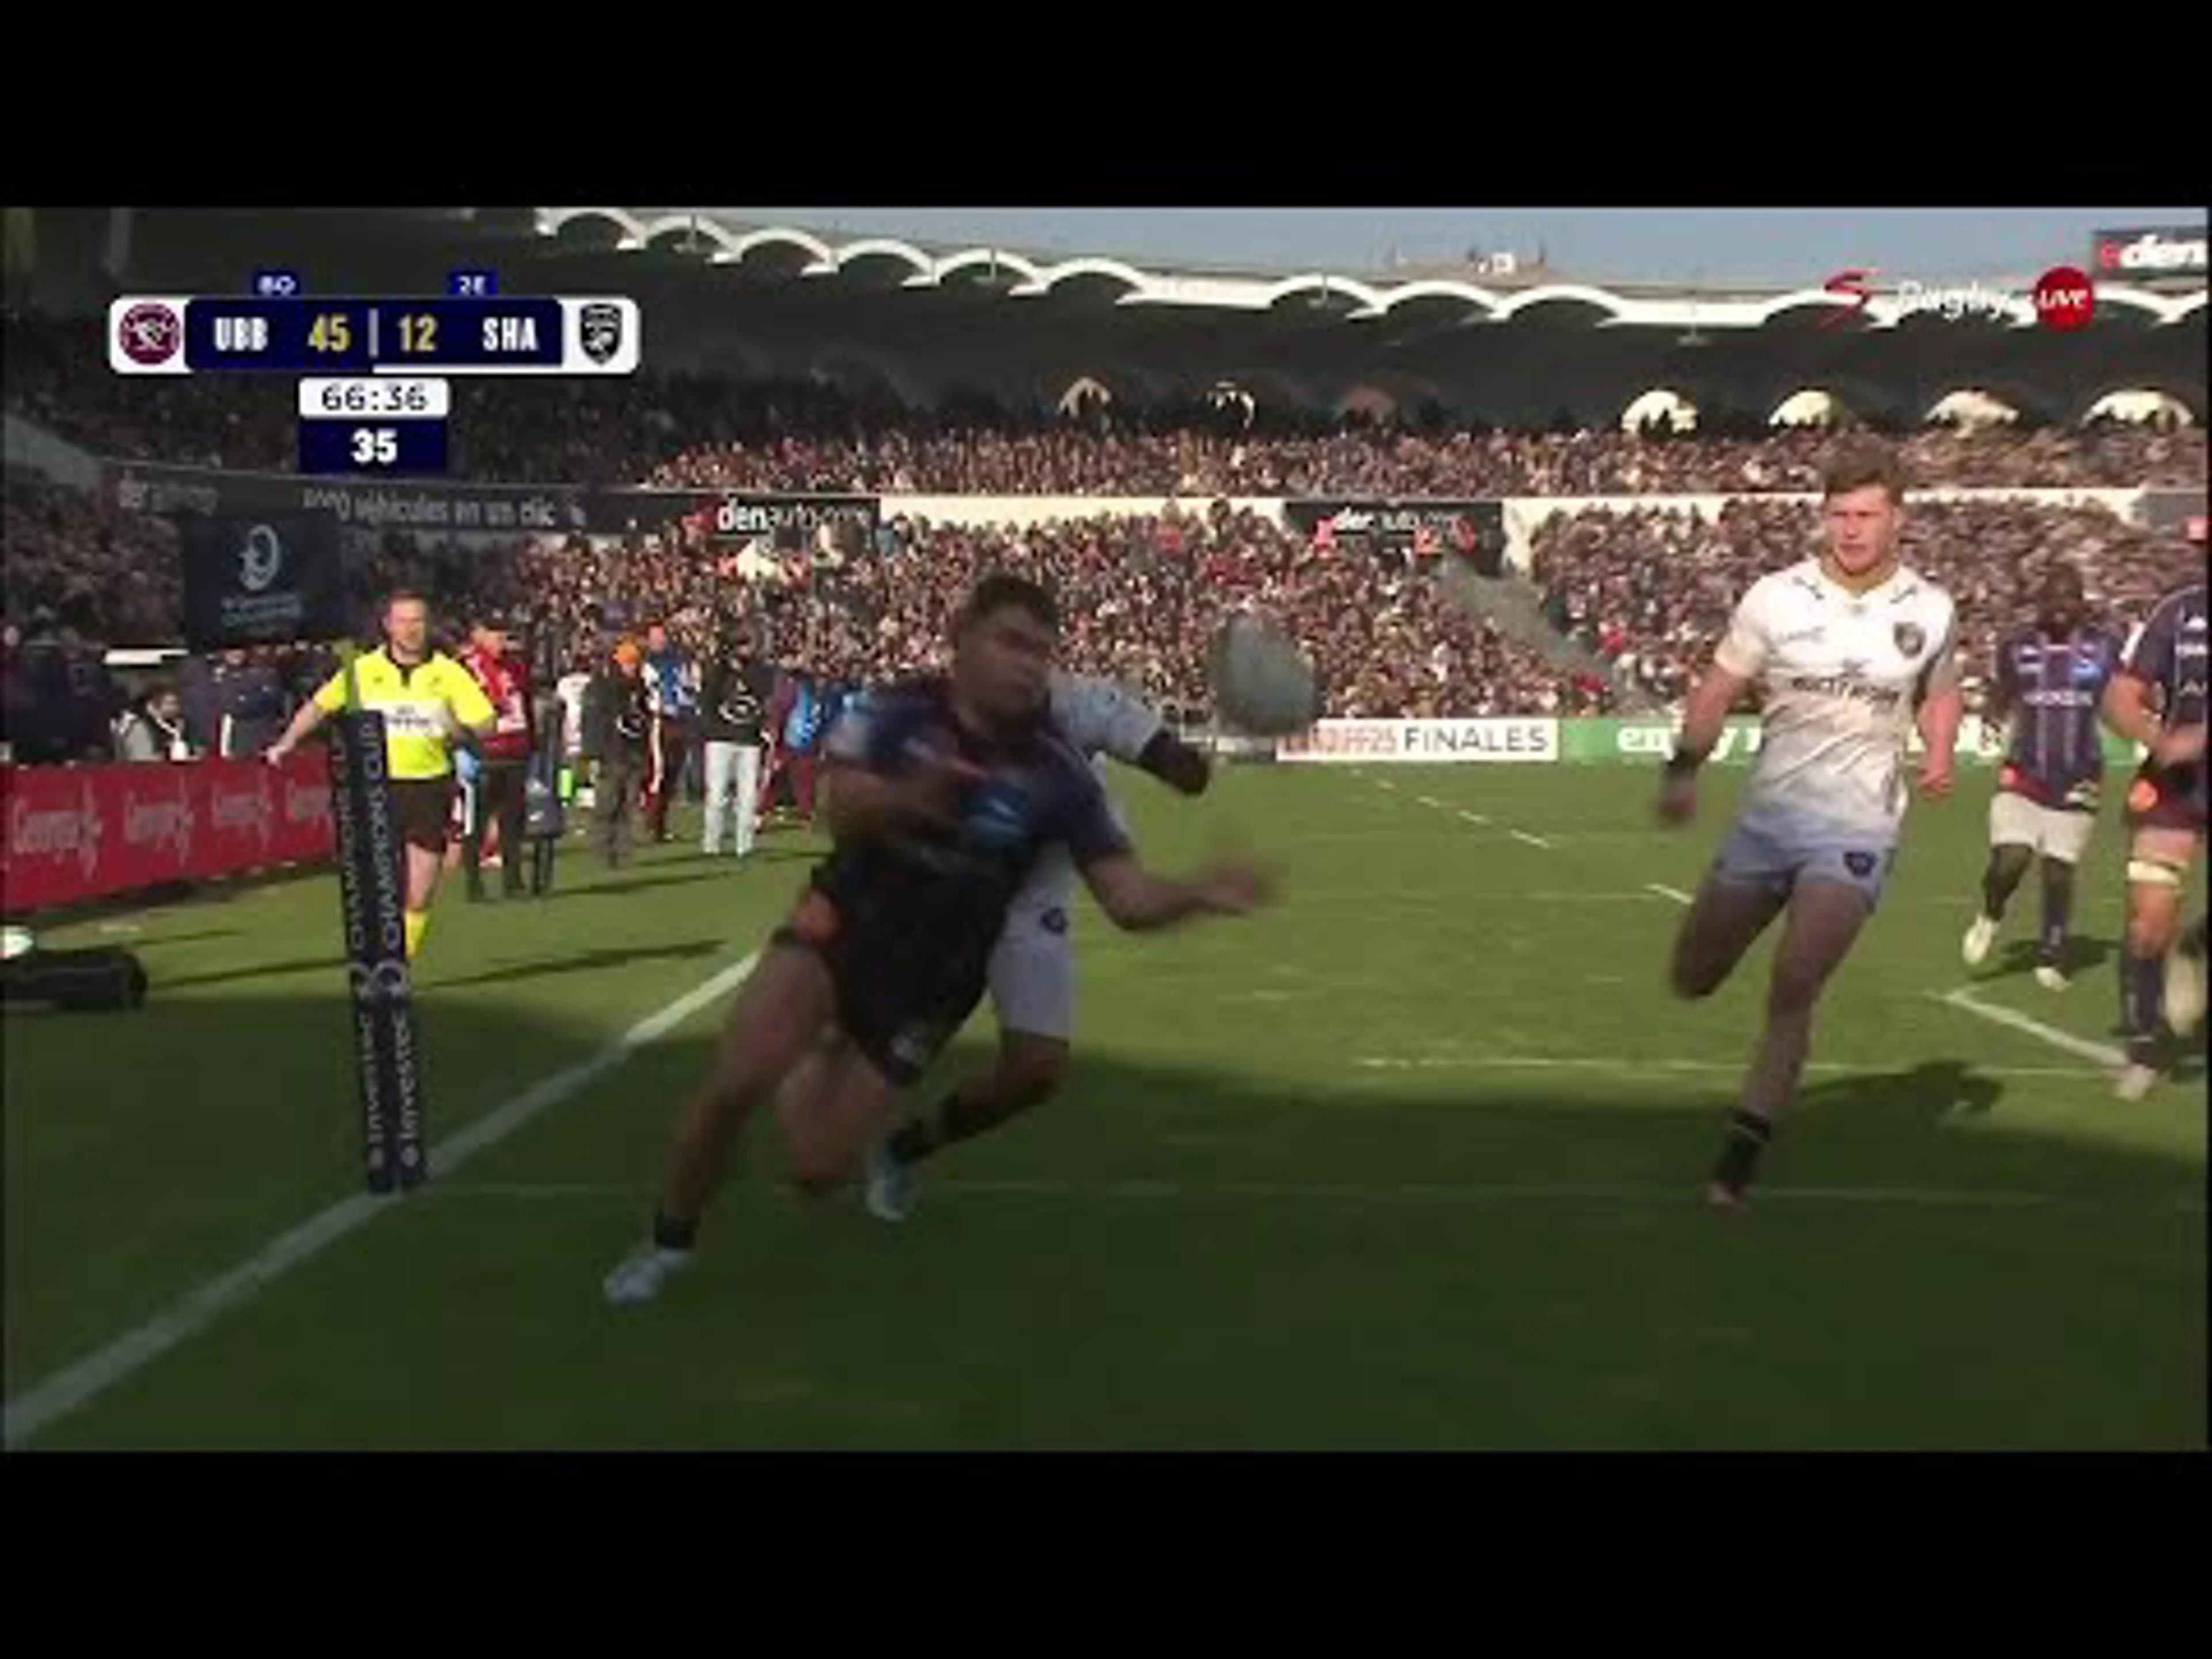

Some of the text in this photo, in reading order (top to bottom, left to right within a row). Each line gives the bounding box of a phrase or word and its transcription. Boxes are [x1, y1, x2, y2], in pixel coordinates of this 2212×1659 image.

[1404, 726, 1549, 752] FINALES
[368, 785, 400, 950] CHAMPIONS
[391, 1010, 418, 1141] Investec
